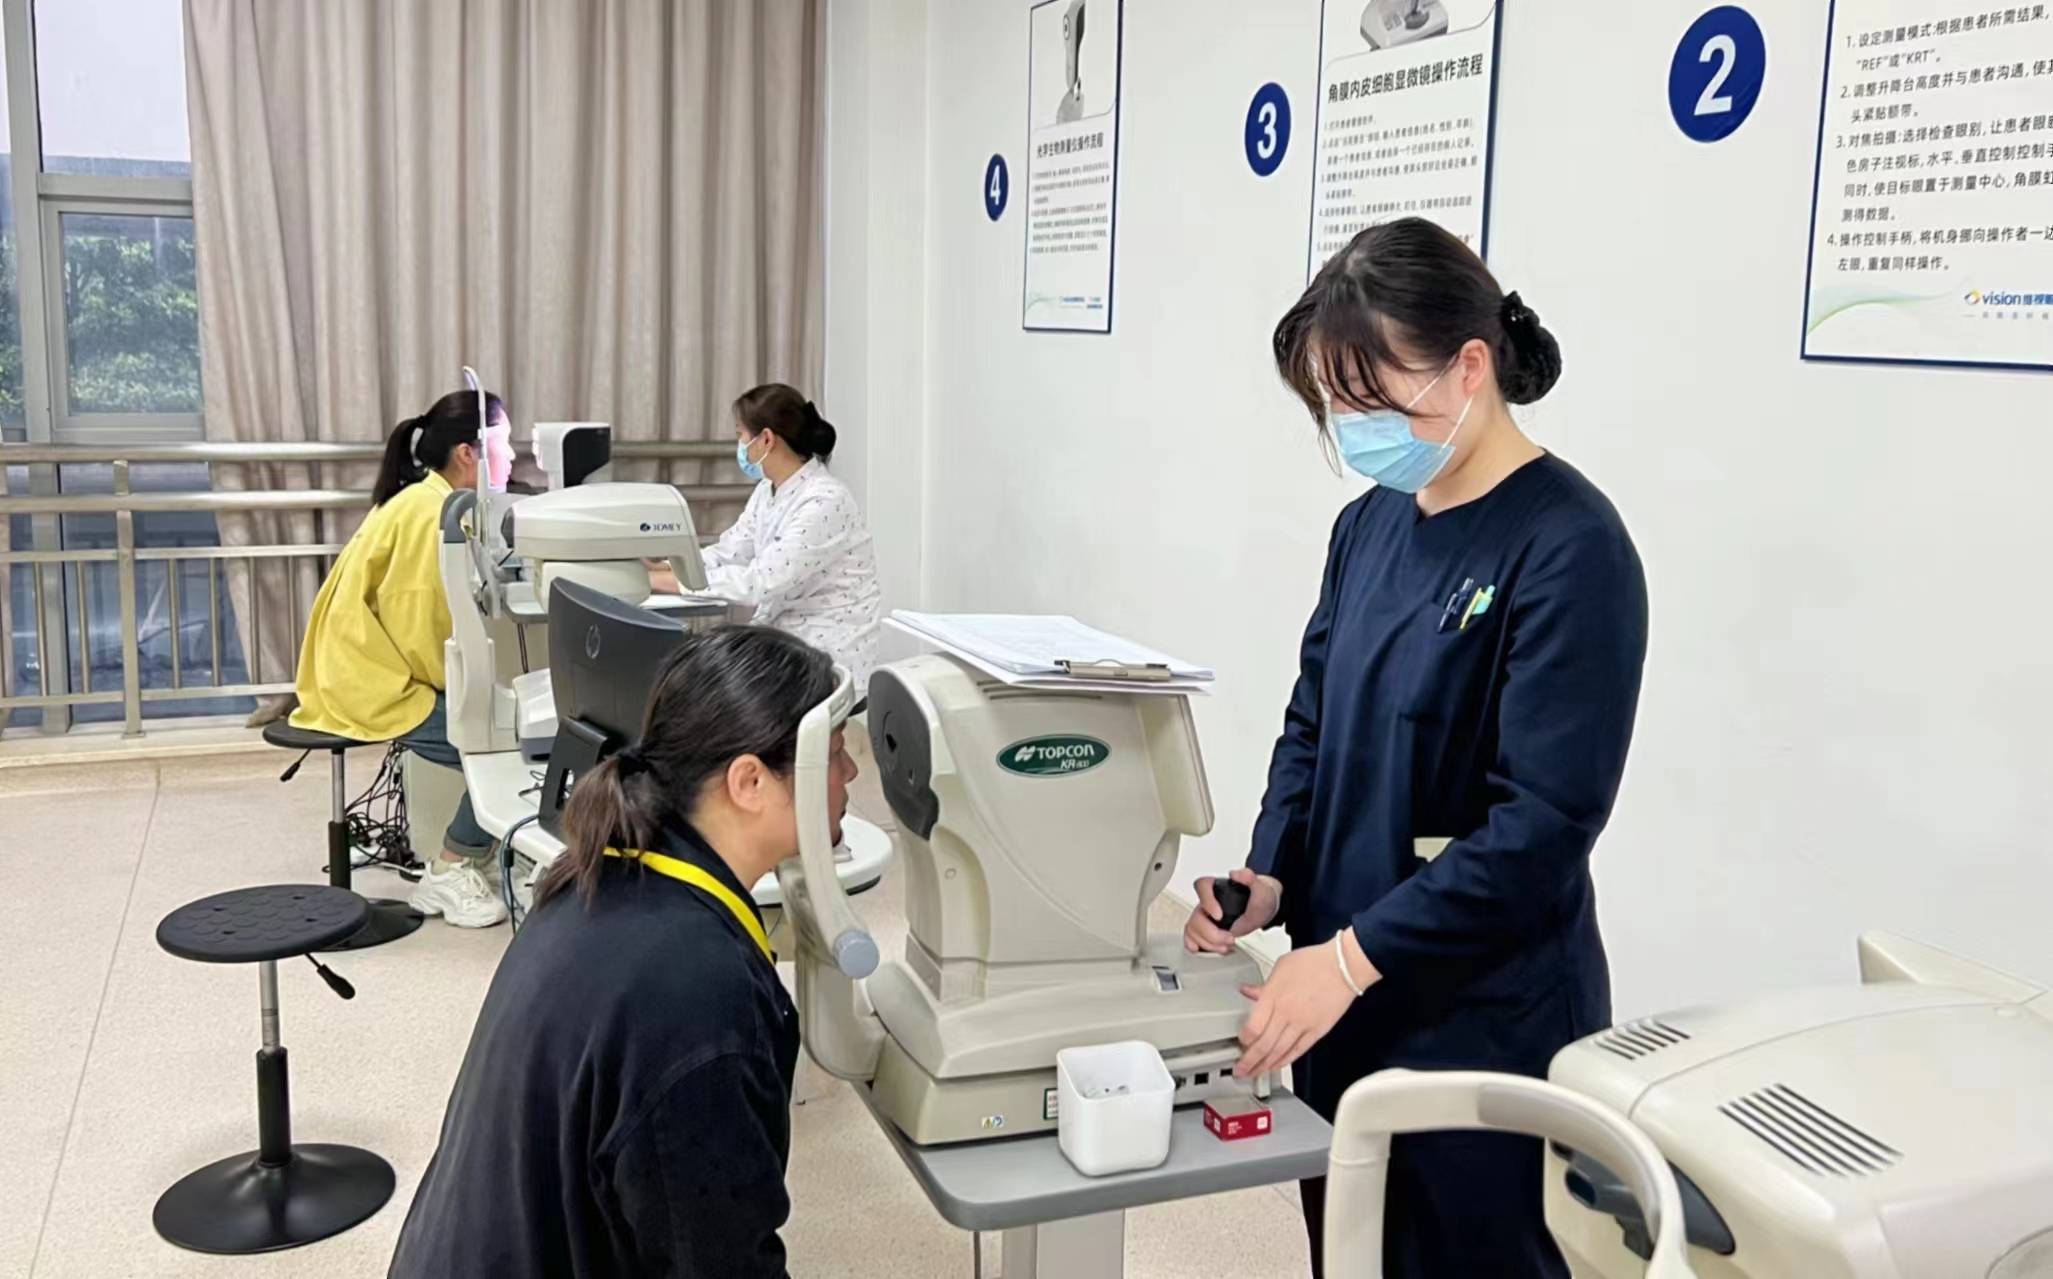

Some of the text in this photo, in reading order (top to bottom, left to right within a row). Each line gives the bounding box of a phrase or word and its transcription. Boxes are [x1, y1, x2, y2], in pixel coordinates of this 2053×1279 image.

[1328, 53, 1483, 104] 角膜内皮细胞显微镜操作流程
[1694, 34, 1736, 116] 2
[1257, 101, 1277, 159] 3
[990, 164, 1001, 206] 4
[1037, 743, 1095, 760] TOPCON
